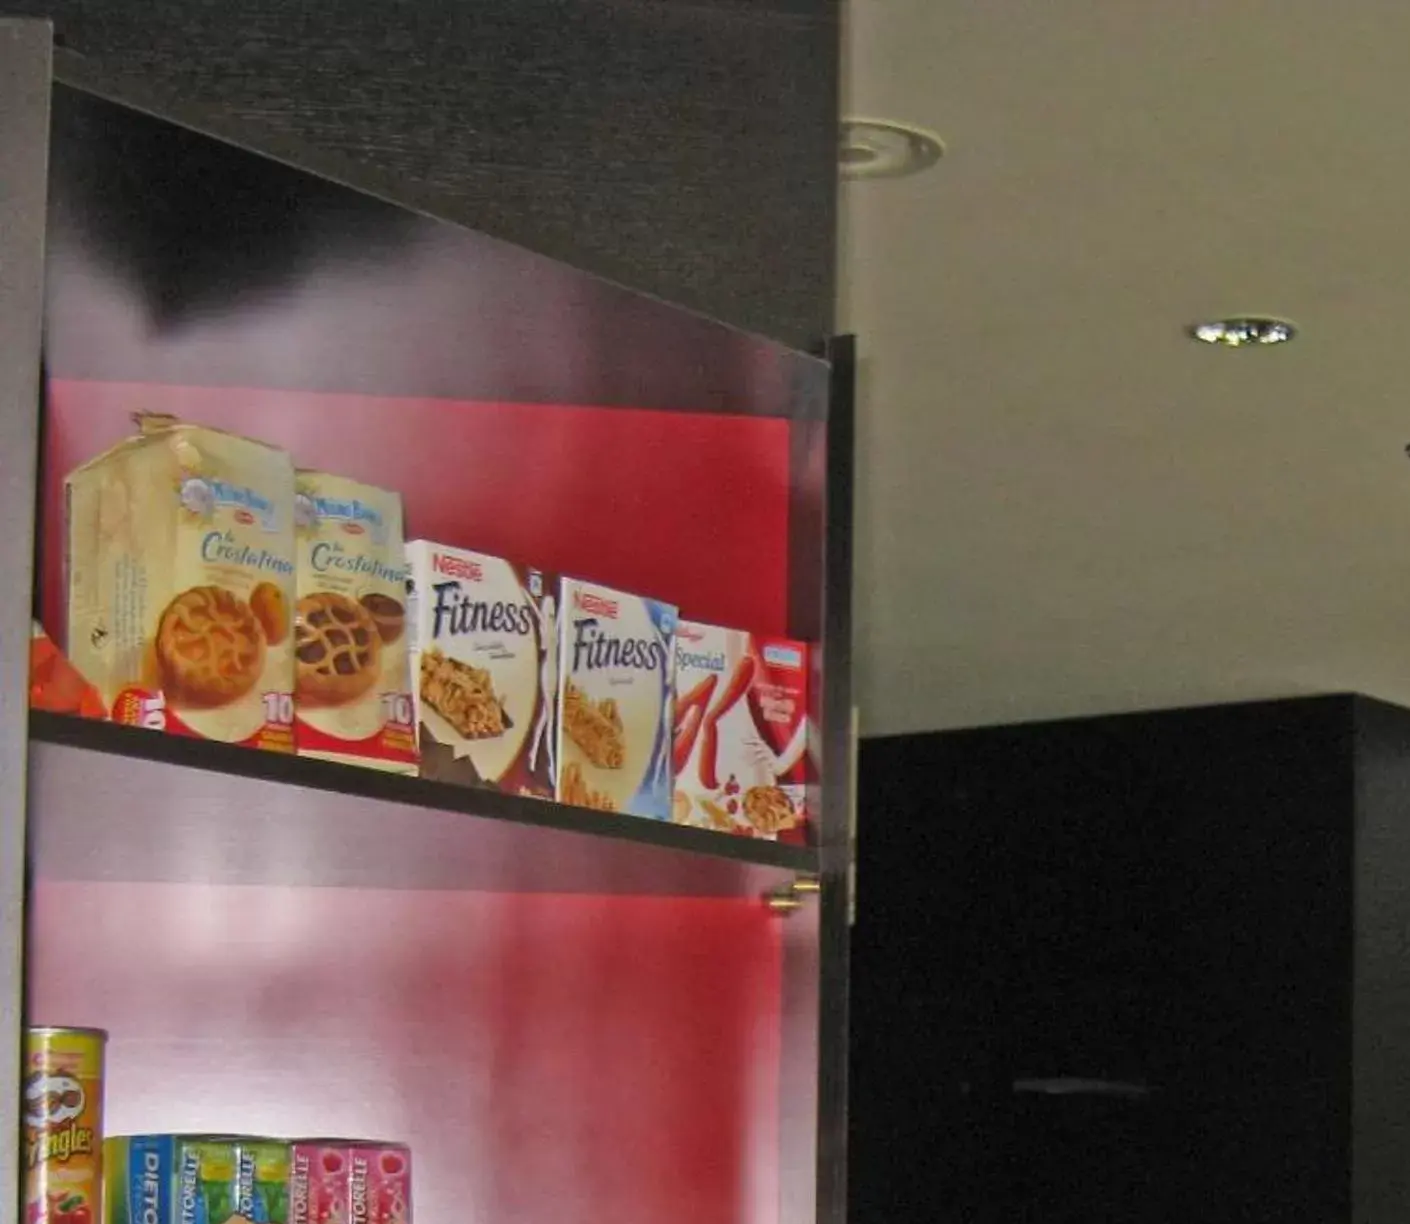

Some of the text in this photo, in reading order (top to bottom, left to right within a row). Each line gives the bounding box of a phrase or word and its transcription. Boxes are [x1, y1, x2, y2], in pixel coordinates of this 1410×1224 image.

[202, 531, 294, 576] Crostatina
[311, 542, 406, 583] Crostatina
[432, 580, 531, 639] Fitness
[572, 617, 662, 673] Fitness
[676, 642, 725, 671] Special
